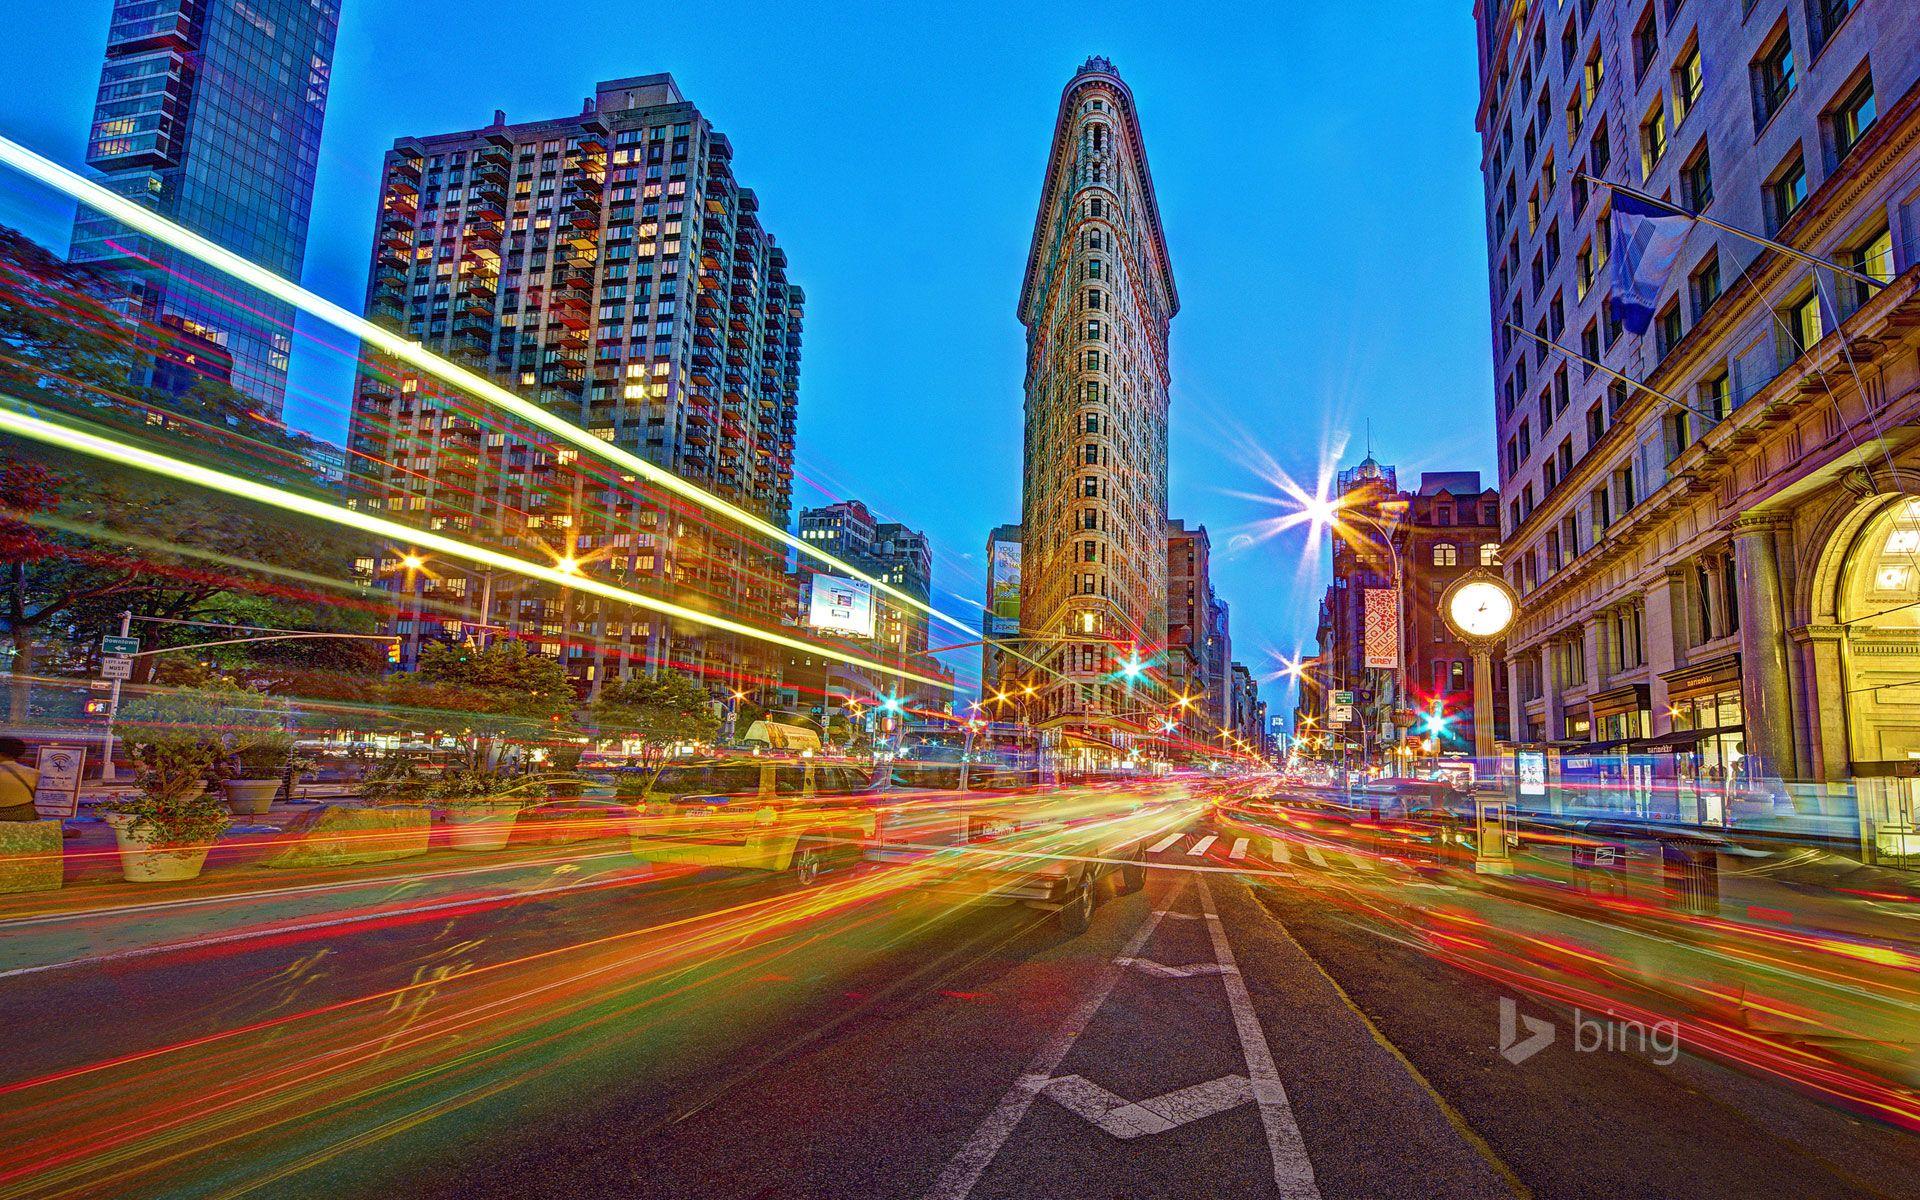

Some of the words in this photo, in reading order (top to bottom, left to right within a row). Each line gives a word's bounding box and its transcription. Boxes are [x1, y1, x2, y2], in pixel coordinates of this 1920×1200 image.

[1370, 657, 1392, 665] GREY
[1686, 675, 1712, 687] marimekko
[1647, 744, 1673, 753] marimekko
